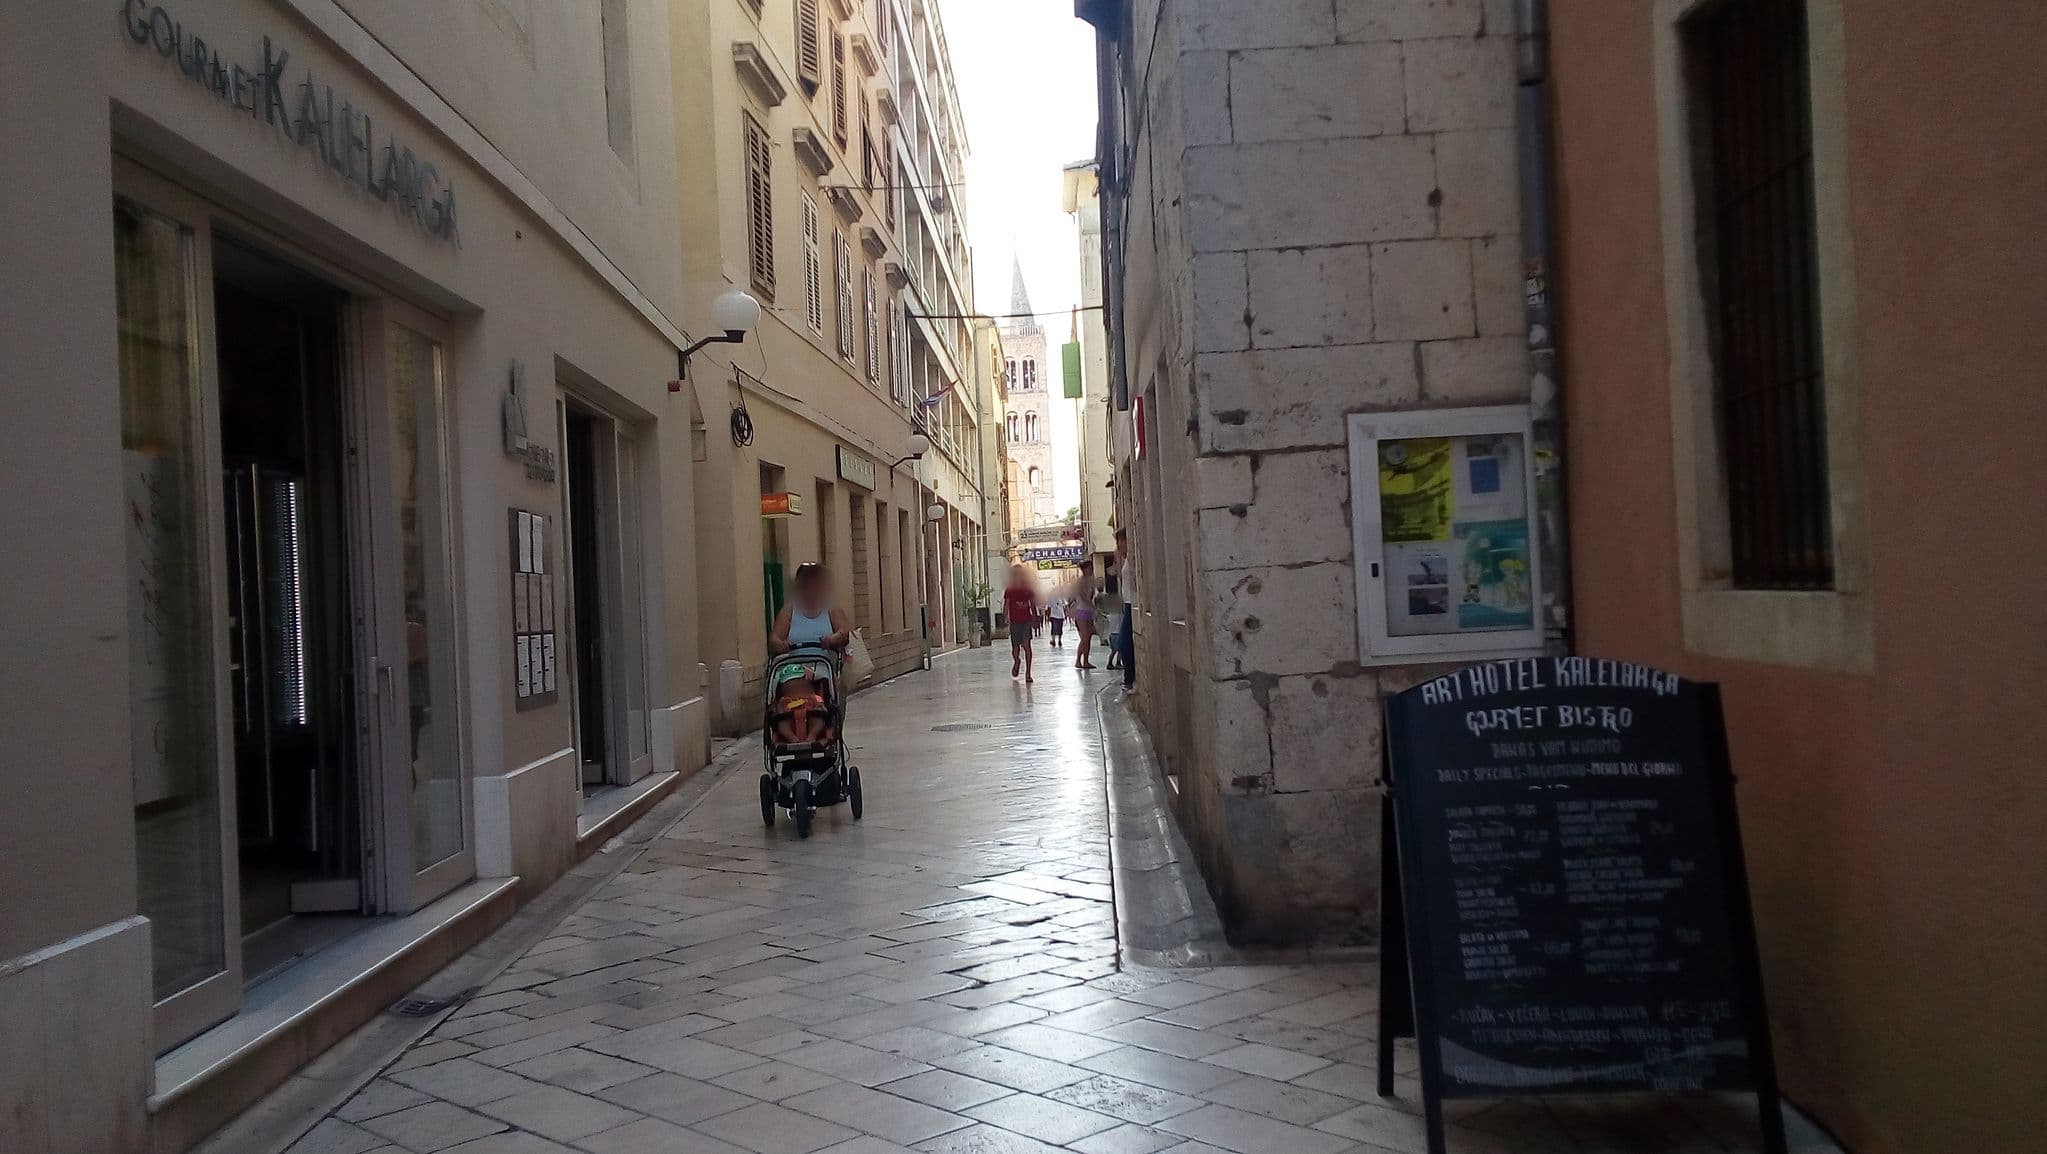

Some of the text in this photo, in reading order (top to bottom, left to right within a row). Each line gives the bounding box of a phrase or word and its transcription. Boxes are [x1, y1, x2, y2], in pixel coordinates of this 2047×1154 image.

[124, 0, 462, 251] GOURMET KALELARGA
[1422, 672, 1462, 704] ART
[1468, 658, 1546, 696] HOTEL
[1558, 705, 1633, 733] BISTRO
